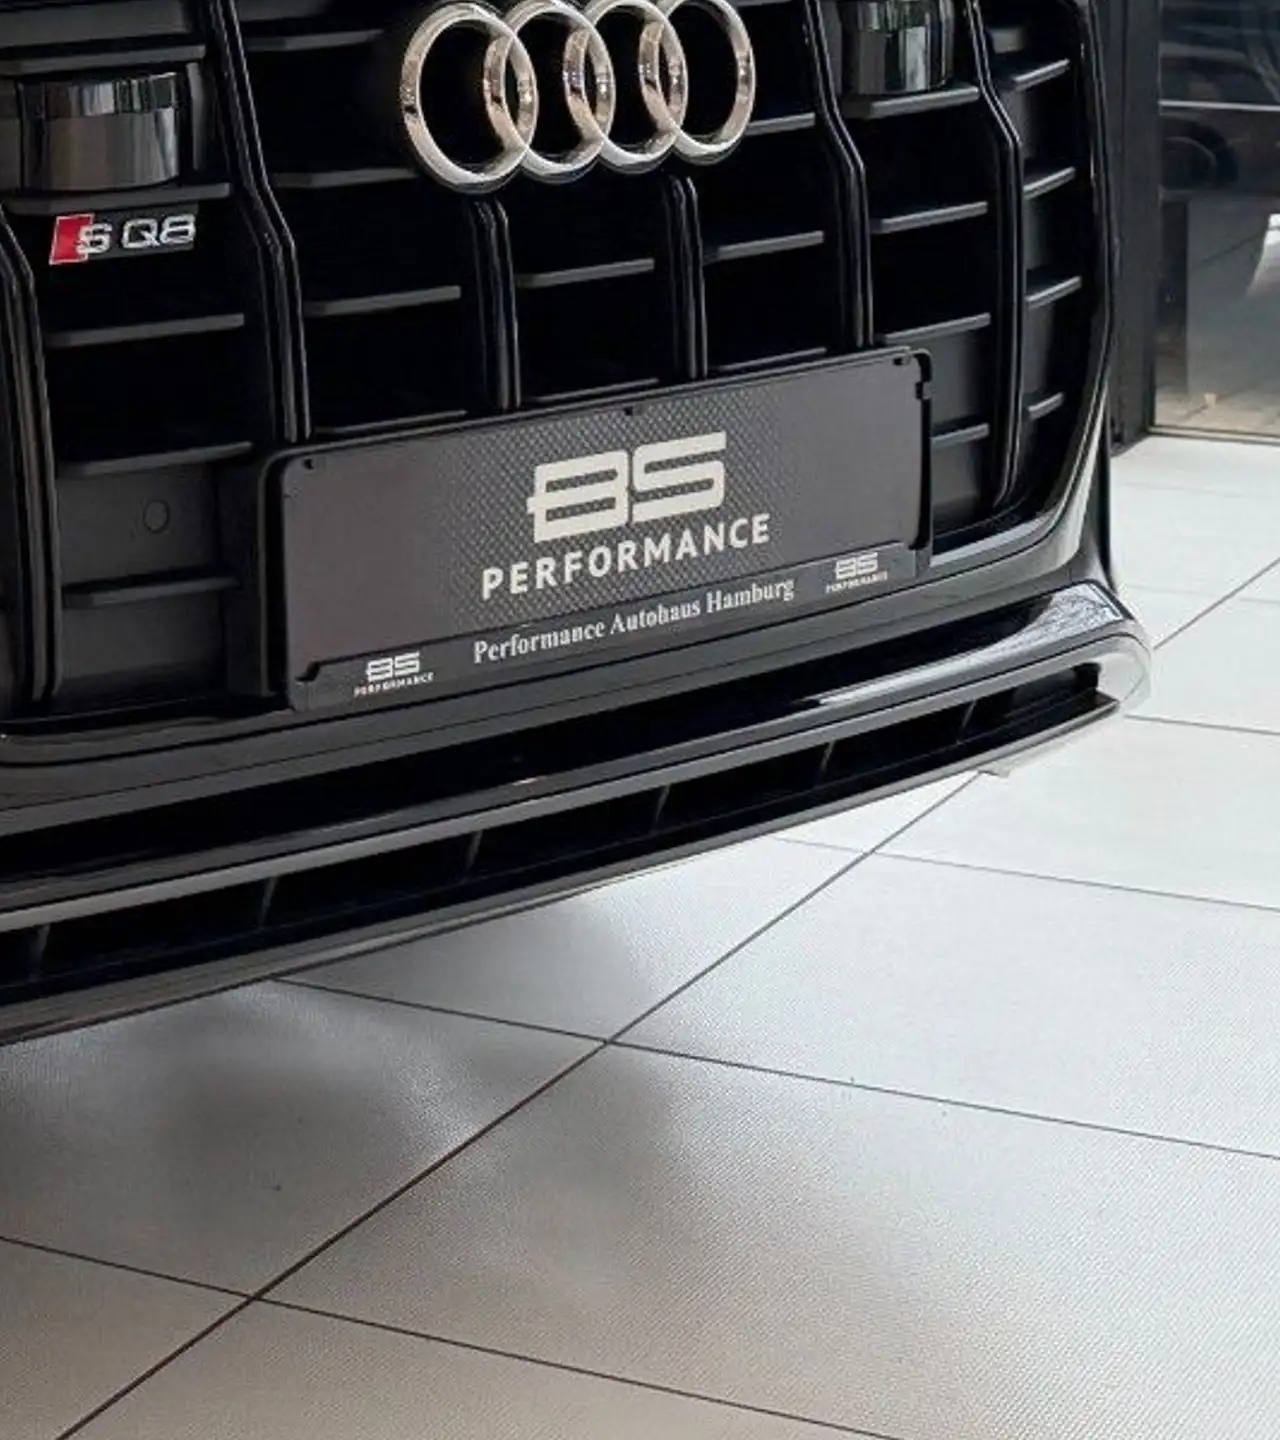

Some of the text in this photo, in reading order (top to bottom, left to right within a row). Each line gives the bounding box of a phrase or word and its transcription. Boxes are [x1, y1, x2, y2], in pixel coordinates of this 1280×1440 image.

[481, 513, 771, 600] PERFORMANCE
[473, 577, 795, 663] Performance Autohaus Hamburg
